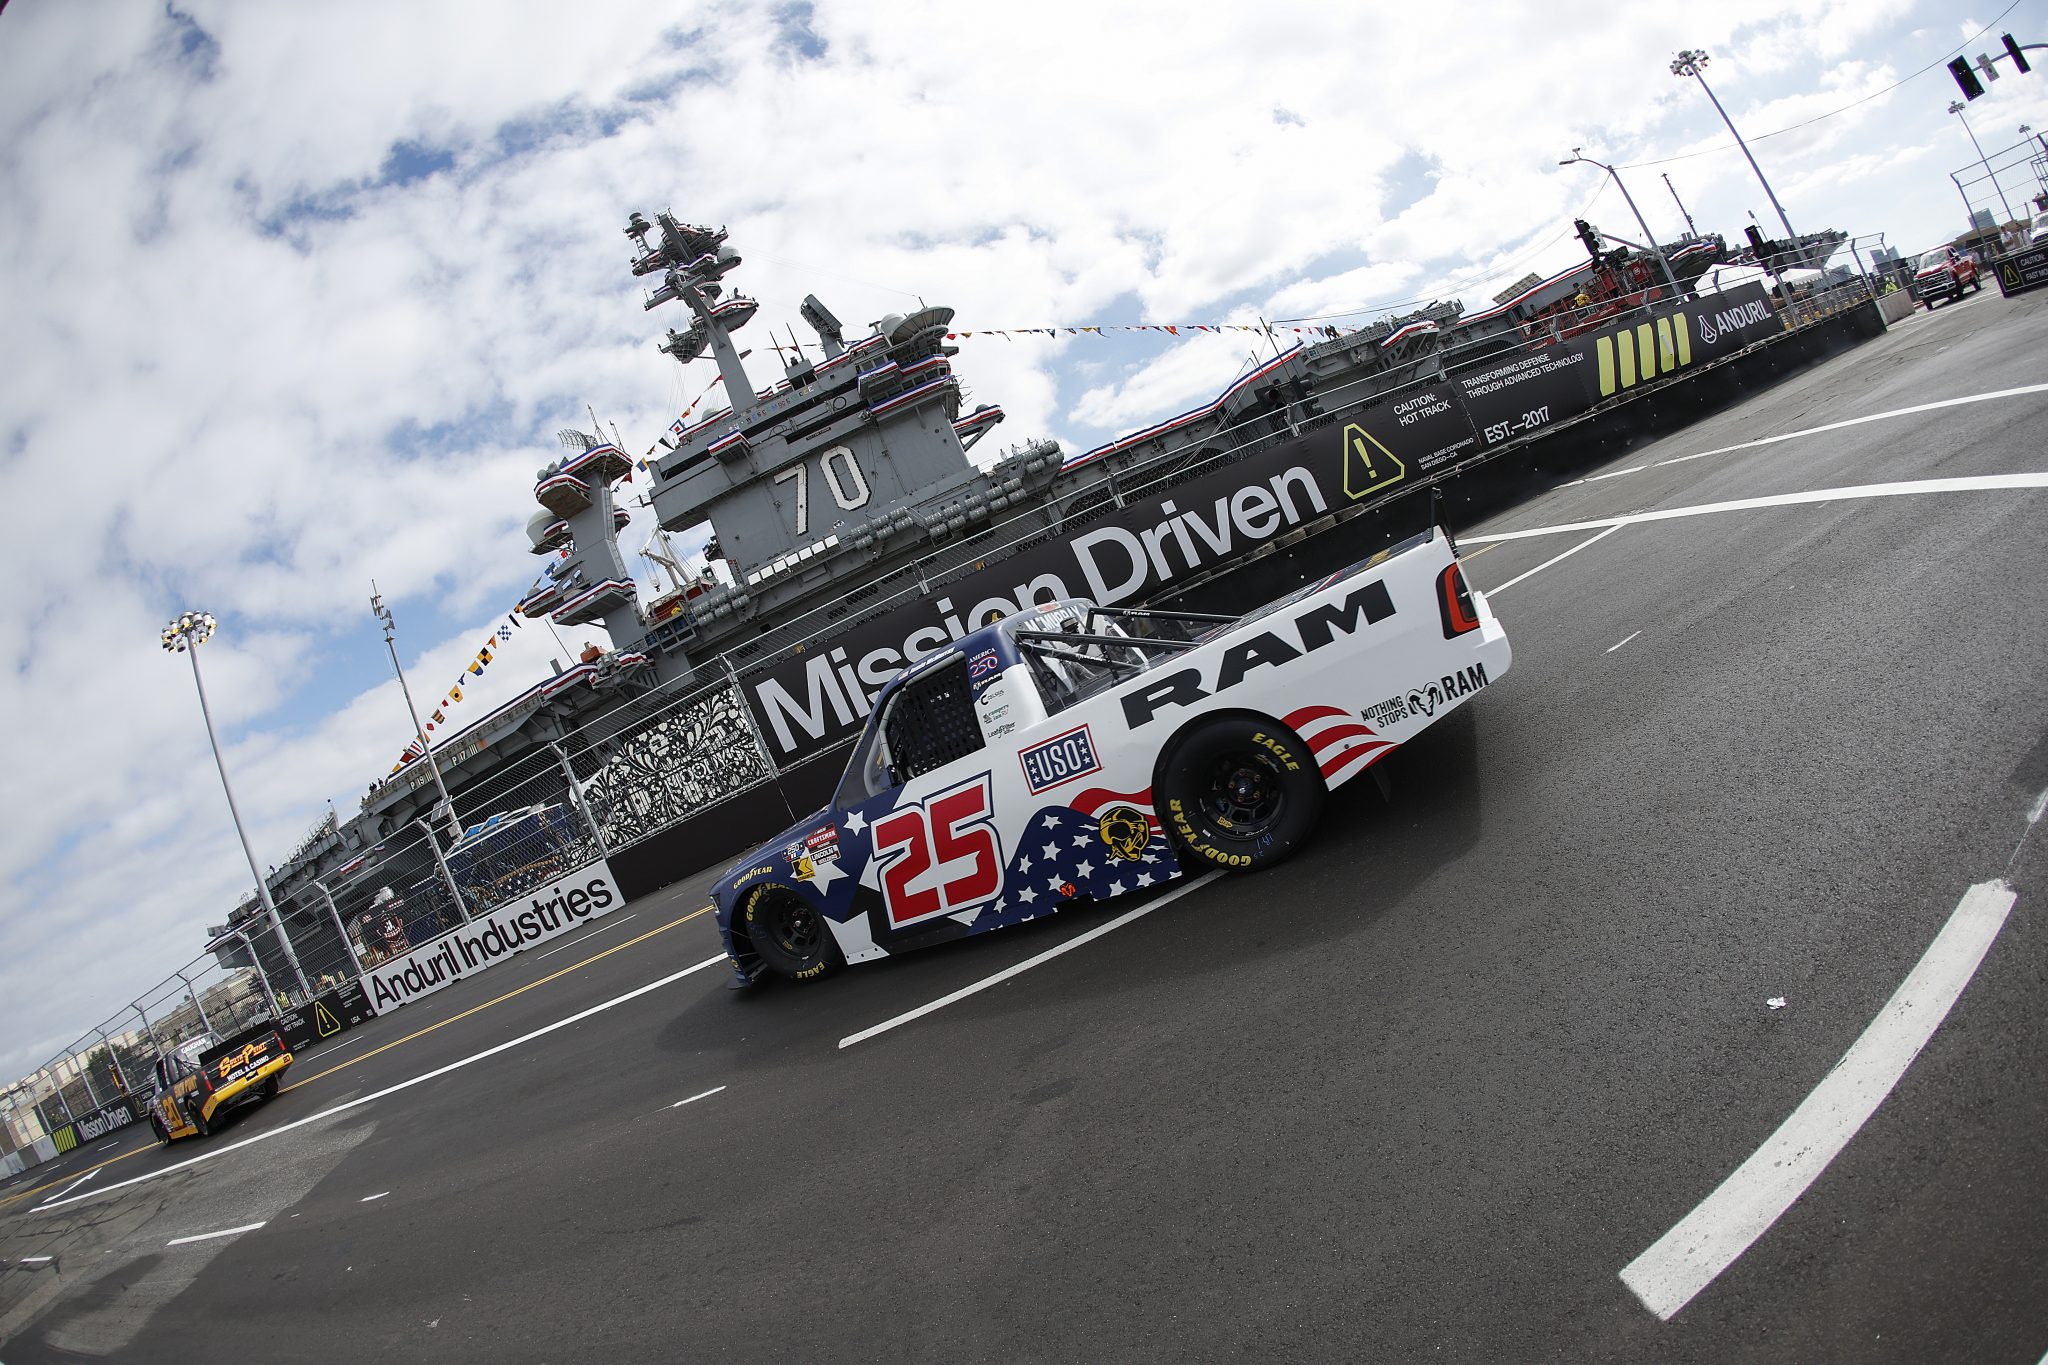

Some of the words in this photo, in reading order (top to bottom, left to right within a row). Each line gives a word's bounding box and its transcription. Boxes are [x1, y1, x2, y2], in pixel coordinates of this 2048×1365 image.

[1715, 299, 1772, 335] ANDURIL
[1461, 363, 1520, 389] TRANSFORMING
[1519, 353, 1550, 371] DEFENSE
[1466, 380, 1505, 399] THROUGH
[1504, 367, 1541, 386] ADVANCED
[1541, 352, 1584, 373] TECHNOLOGY
[1394, 393, 1437, 415] CAUTION:
[1398, 411, 1419, 427] HOT
[1419, 399, 1452, 419] TRACK
[1418, 452, 1434, 465] NAVAL
[1433, 447, 1447, 460] BASE
[1446, 437, 1474, 453] CORONADO
[1420, 460, 1432, 471] SAN
[774, 445, 872, 536] 70
[1070, 466, 1328, 607] Driven
[969, 647, 996, 664] AMERICA
[969, 655, 998, 678] 250
[1120, 579, 1397, 730] RAM
[1441, 662, 1489, 701] RAM
[1361, 695, 1404, 721] NOTHING
[1376, 707, 1409, 728] STOPS
[1035, 739, 1082, 781] USO
[1252, 732, 1301, 771] EAGLE
[1169, 798, 1252, 867] GOODYEAR
[811, 846, 834, 861] LINCOLN
[870, 769, 1006, 931] 25
[733, 866, 773, 889] GOODYEAR
[371, 940, 462, 1009] Anduril
[453, 878, 613, 969] Industries
[796, 961, 825, 979] EAGLE
[351, 1015, 361, 1024] USA
[181, 1038, 206, 1054] GAUGHAN
[283, 1053, 291, 1063] 20
[227, 1069, 245, 1082] HOTEL
[250, 1055, 270, 1067] CASINO
[76, 1116, 106, 1141] Mission
[101, 1105, 133, 1130] Driven
